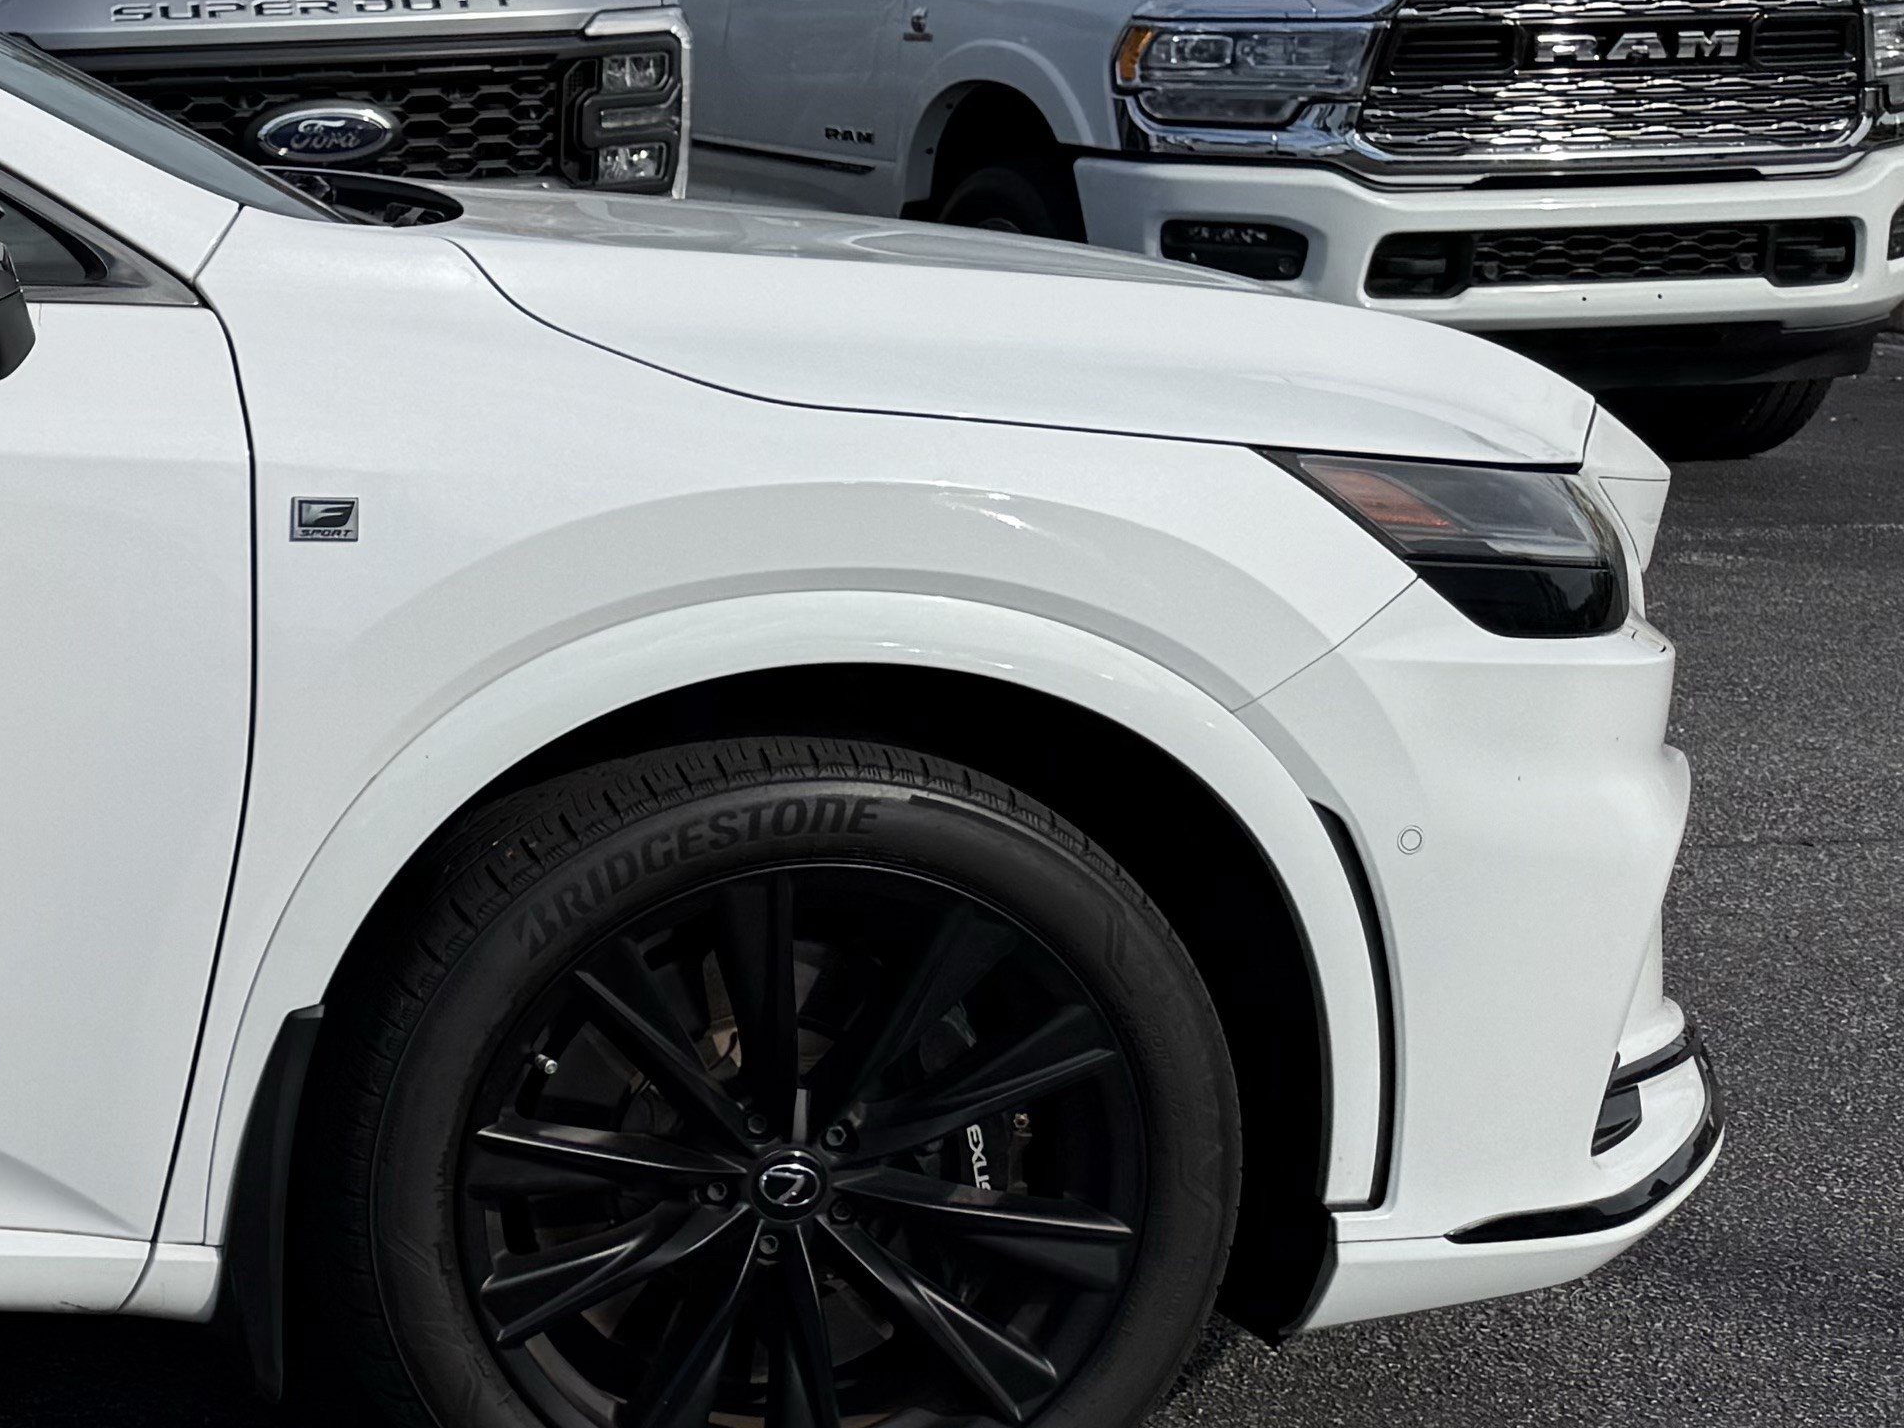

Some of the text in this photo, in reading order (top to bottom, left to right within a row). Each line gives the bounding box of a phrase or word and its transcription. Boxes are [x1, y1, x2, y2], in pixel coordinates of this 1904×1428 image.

[1534, 29, 1742, 63] RAM
[290, 119, 362, 150] Ford
[299, 529, 354, 537] SPORT
[512, 796, 883, 962] BRIDGESTONE
